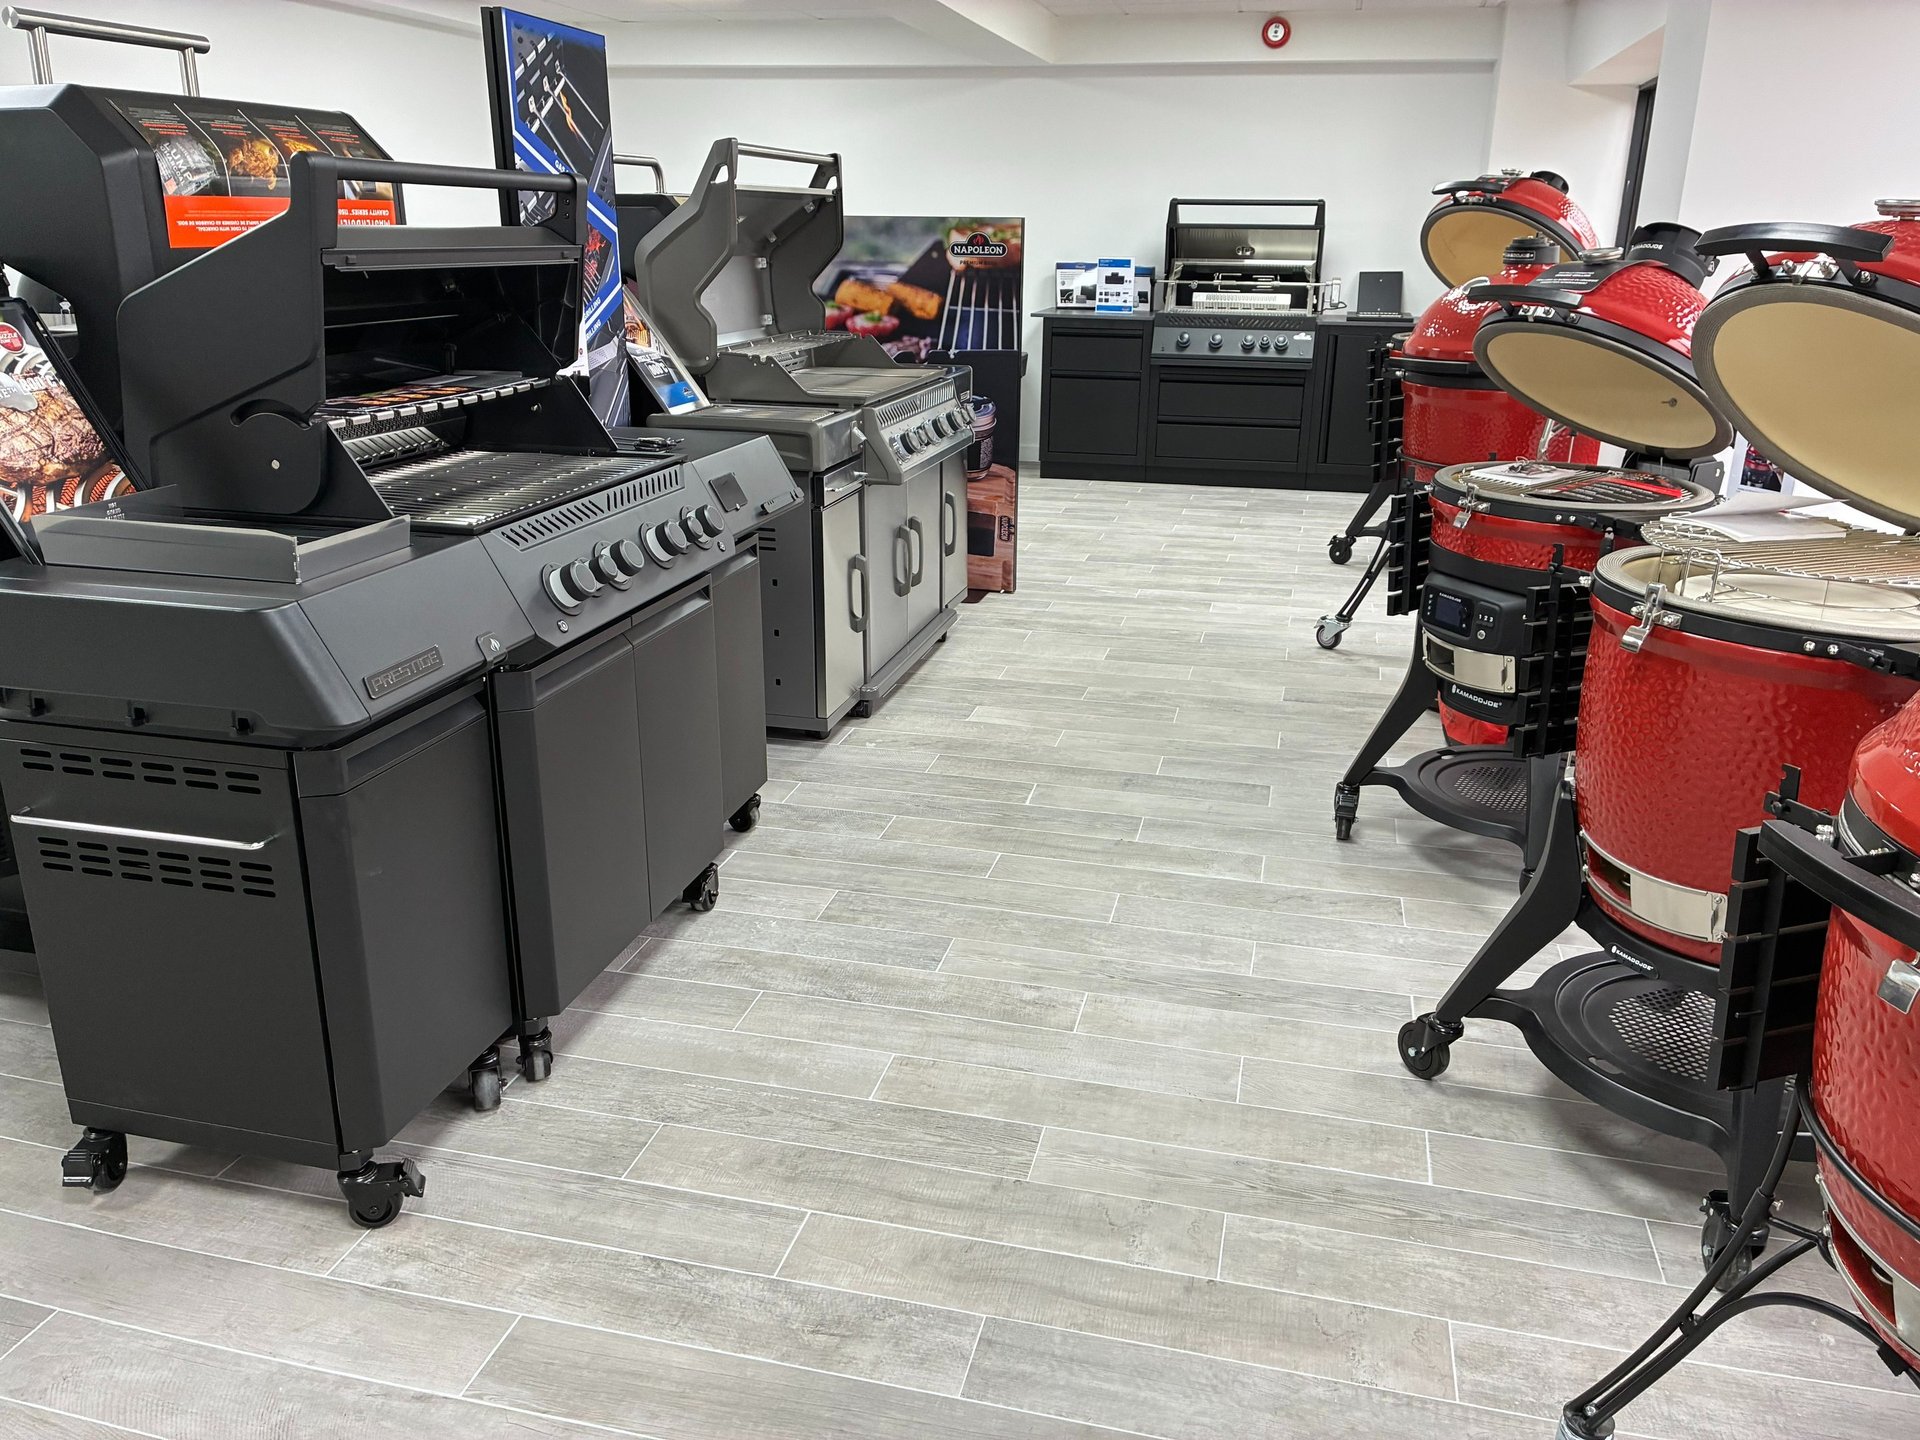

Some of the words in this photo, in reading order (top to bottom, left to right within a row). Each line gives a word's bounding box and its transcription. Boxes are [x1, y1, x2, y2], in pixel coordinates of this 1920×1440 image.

[953, 245, 1004, 255] NAPOLEON
[1001, 516, 1009, 541] NAPOLEON
[371, 651, 439, 691] PRESTIGE
